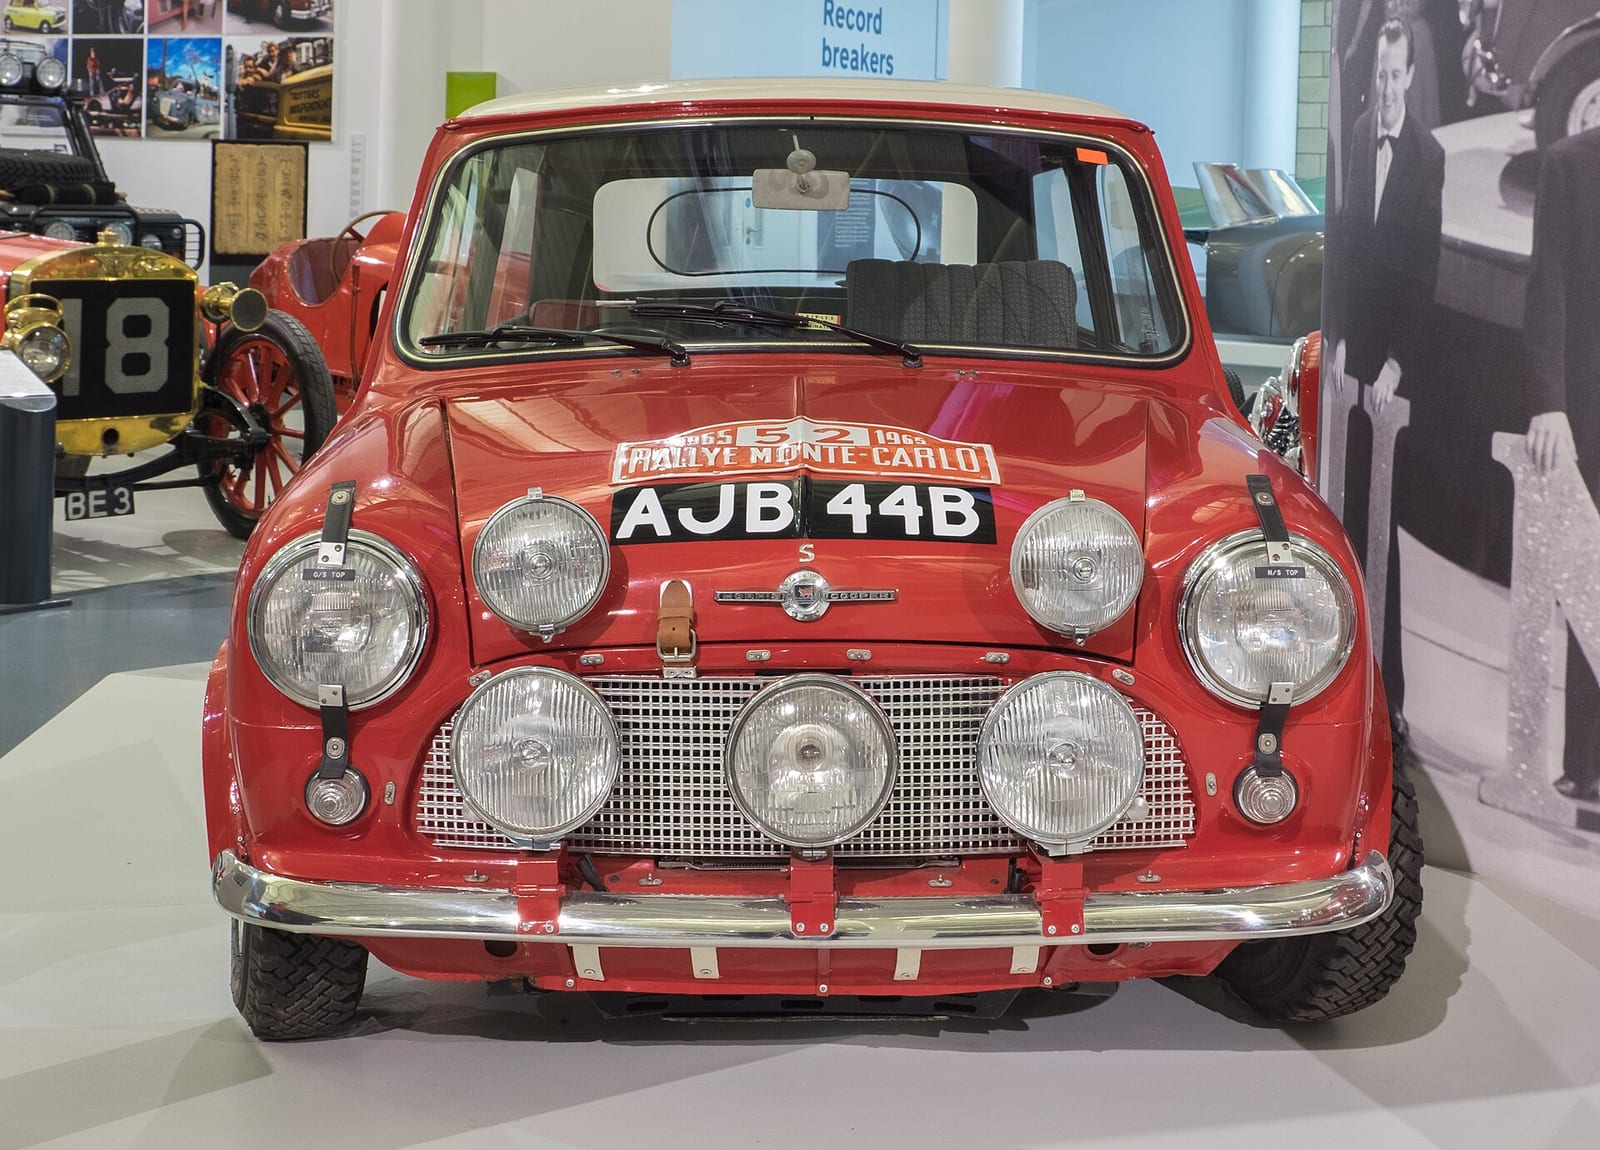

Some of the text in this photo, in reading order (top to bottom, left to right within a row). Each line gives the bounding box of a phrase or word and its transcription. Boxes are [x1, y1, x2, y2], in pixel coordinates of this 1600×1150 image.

[824, 0, 882, 34] Record
[822, 37, 894, 76] breakers
[61, 297, 170, 396] 18
[874, 429, 927, 445] 1965
[628, 446, 739, 473] RALLYE
[68, 487, 130, 519] BE 3
[616, 483, 980, 538] AJB 44B
[799, 543, 815, 562] S
[830, 591, 892, 600] COOPER
